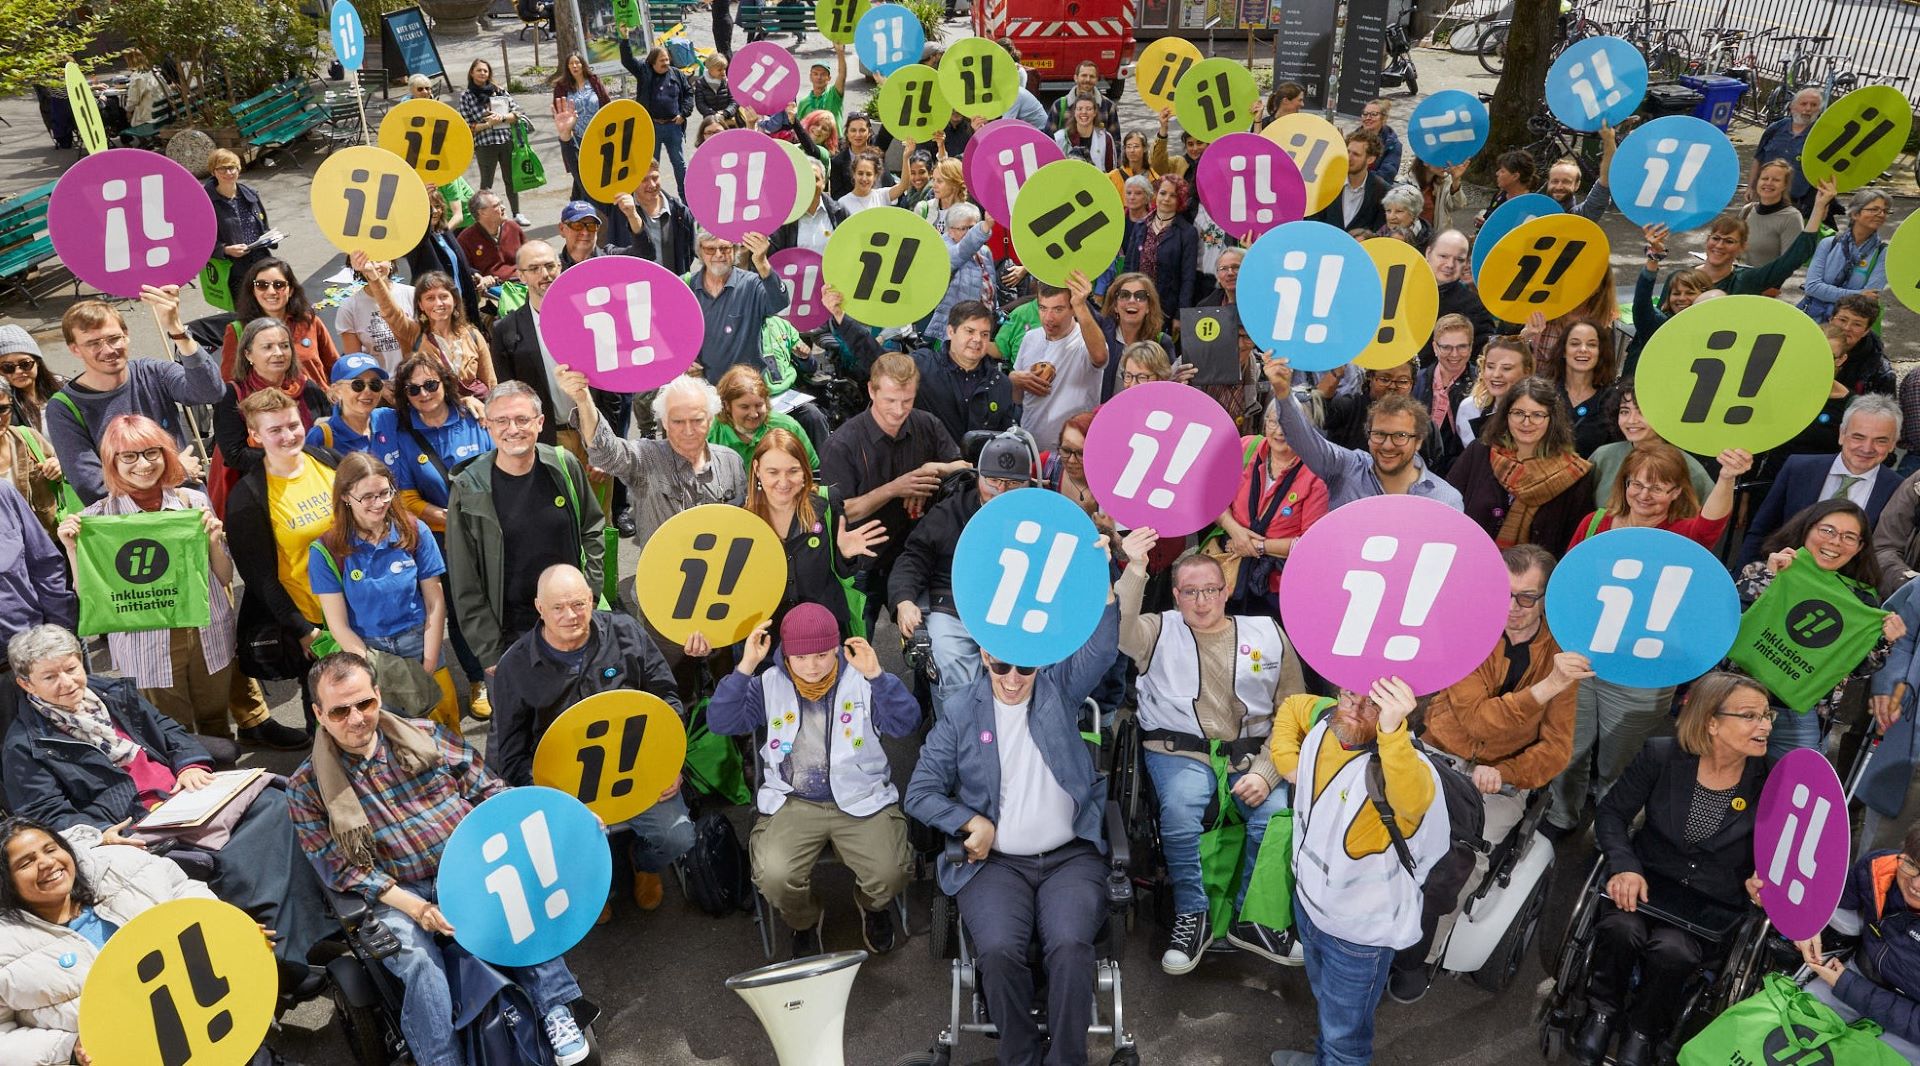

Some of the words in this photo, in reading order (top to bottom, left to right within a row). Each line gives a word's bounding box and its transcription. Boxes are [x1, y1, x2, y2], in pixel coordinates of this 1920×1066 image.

[873, 17, 903, 64] i!
[737, 54, 790, 102] i!
[960, 55, 993, 105] i!
[1197, 72, 1235, 131] i!
[1569, 49, 1621, 119] i!
[405, 117, 449, 170] i!
[600, 118, 635, 187] i!
[1636, 138, 1711, 210] i!
[1817, 107, 1895, 172] i!
[343, 169, 399, 239] i!
[715, 152, 766, 223] i!
[853, 232, 920, 303] i!
[1272, 251, 1344, 343] i!
[1501, 237, 1586, 303] i!
[583, 280, 655, 373] i!
[1202, 321, 1213, 337] i!
[1681, 331, 1785, 425] i!
[1113, 411, 1212, 508] i!
[110, 586, 179, 602] inklusions
[130, 547, 155, 576] i!
[672, 534, 754, 620] i!
[986, 521, 1078, 633] i!
[116, 599, 175, 614] initiative
[1332, 536, 1457, 660] i!
[1590, 559, 1693, 658] i!
[1792, 608, 1837, 639] i!
[1752, 638, 1801, 681] initiative
[1760, 626, 1816, 674] inklusions
[577, 715, 647, 804] i!
[482, 810, 569, 944] i!
